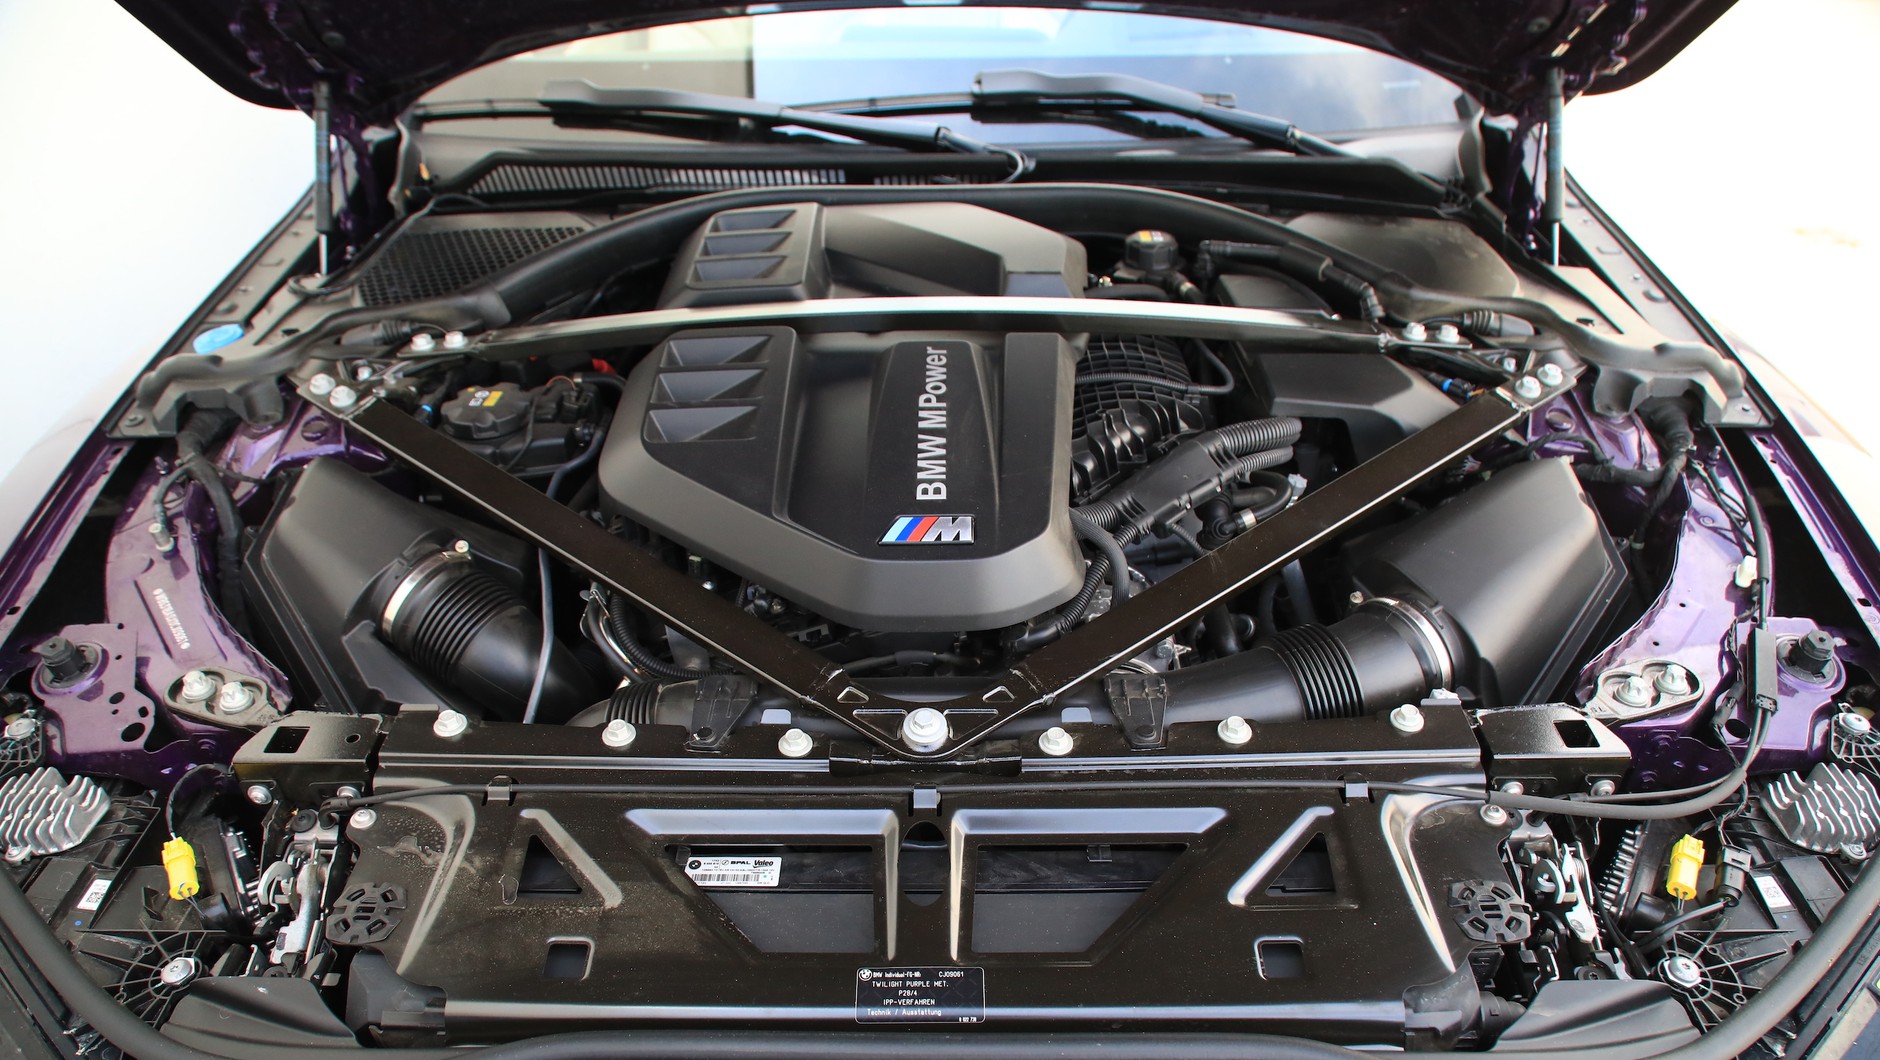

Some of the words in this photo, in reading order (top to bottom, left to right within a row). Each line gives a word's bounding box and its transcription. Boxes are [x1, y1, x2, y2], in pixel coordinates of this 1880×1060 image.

[918, 346, 947, 429] MPower
[916, 433, 947, 500] BMW
[920, 516, 973, 542] M
[753, 860, 774, 868] Valeo
[902, 1009, 942, 1017] Ausstattung
